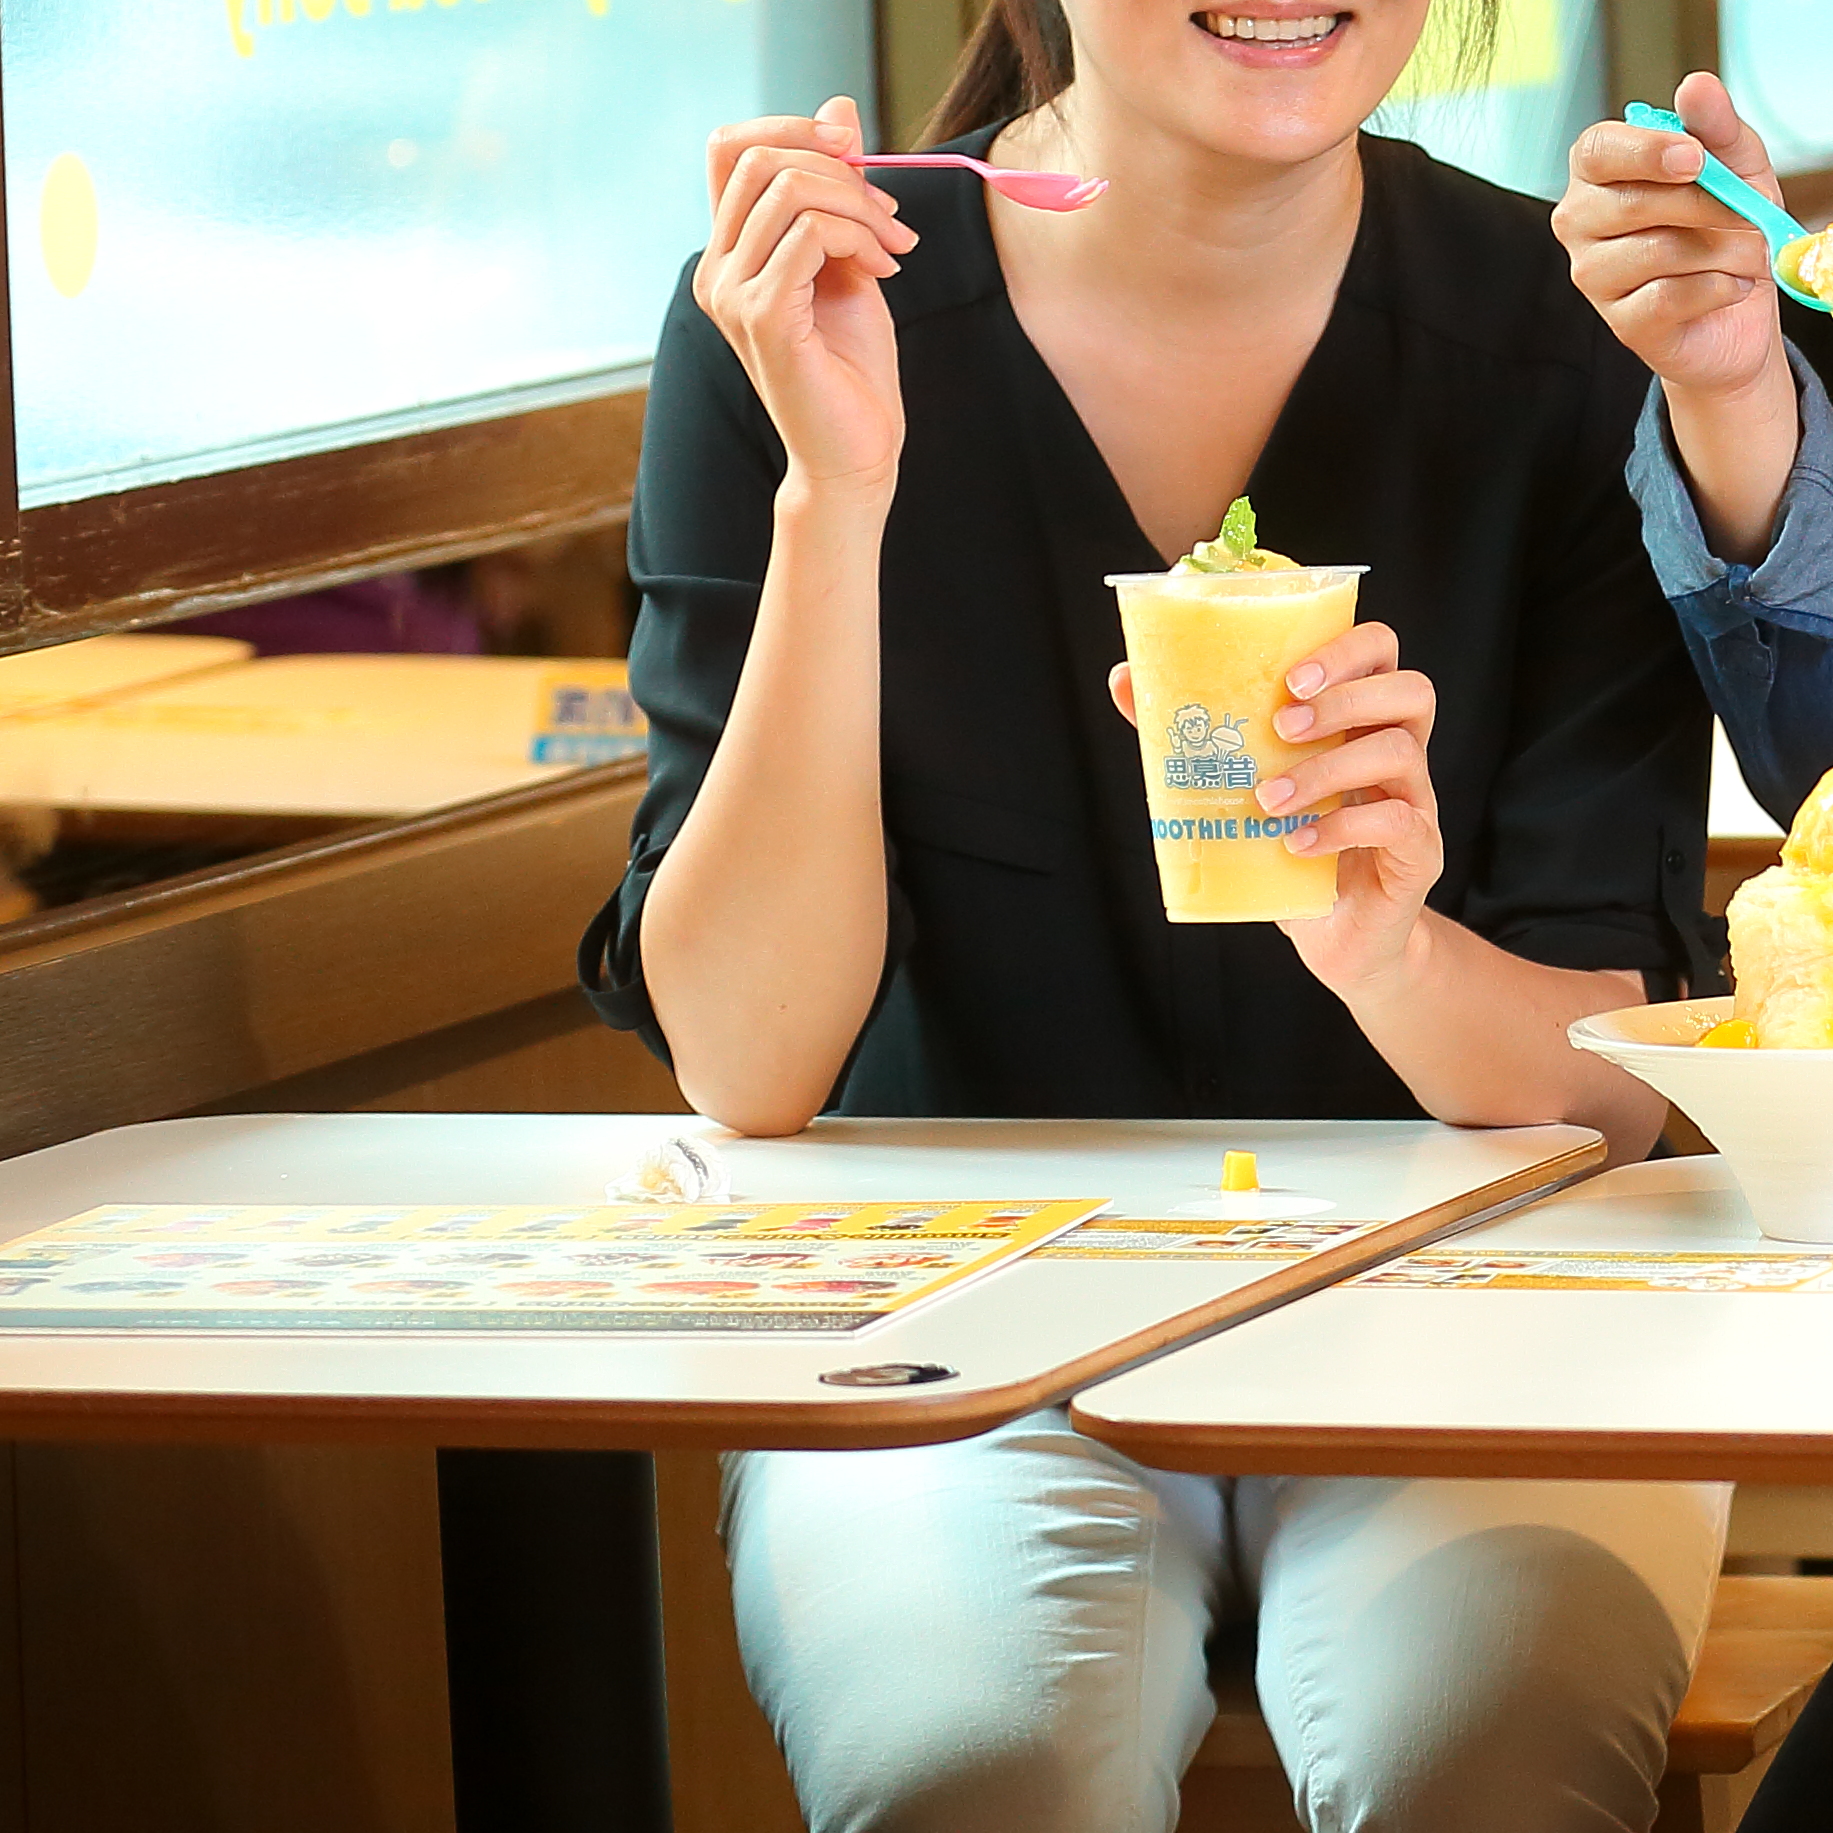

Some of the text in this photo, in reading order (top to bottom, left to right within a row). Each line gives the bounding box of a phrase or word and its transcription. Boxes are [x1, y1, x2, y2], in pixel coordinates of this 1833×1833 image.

[1163, 755, 1258, 790] 思慕昔
[1244, 814, 1320, 840] HOU
